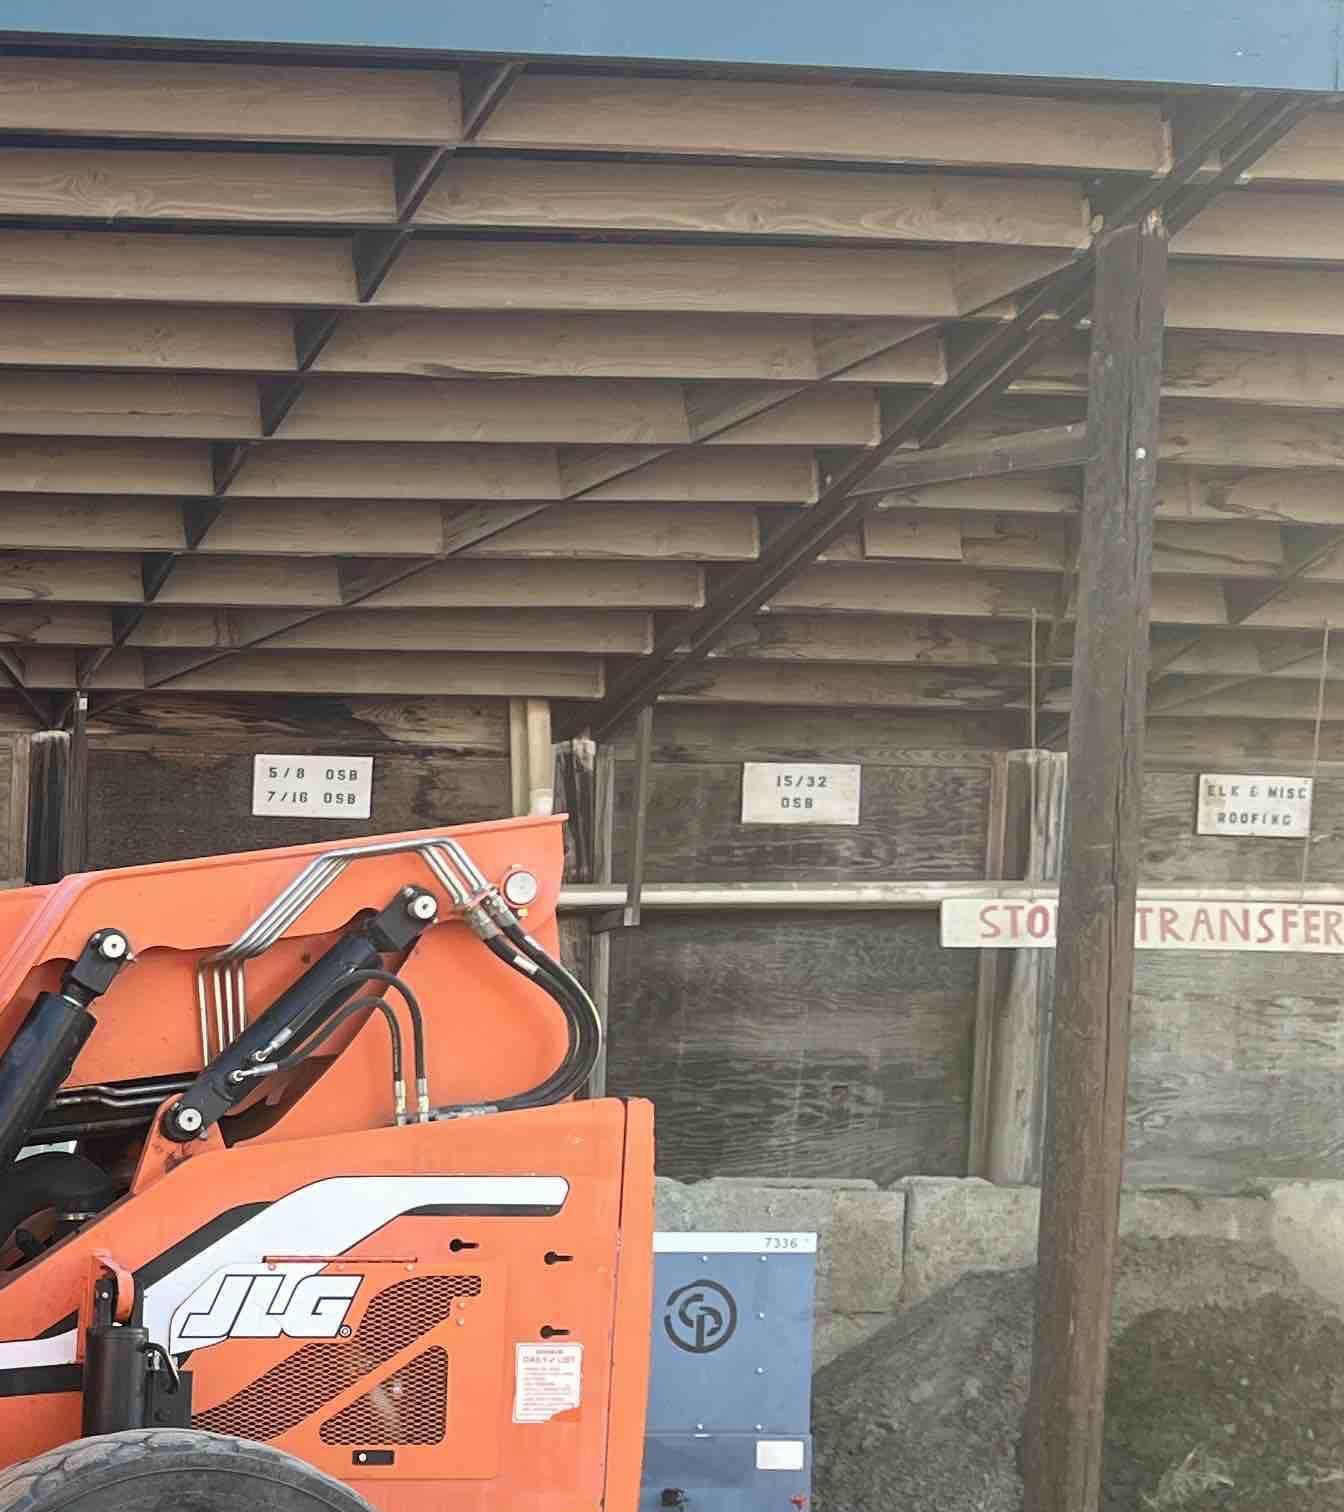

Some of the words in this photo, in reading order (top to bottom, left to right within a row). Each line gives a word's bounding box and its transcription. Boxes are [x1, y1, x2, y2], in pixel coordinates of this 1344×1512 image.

[325, 769, 358, 781] OSB
[776, 775, 827, 788] 15/32
[323, 792, 356, 805] OSB
[1207, 785, 1240, 797] ELK
[1268, 787, 1307, 800] MISC
[1217, 812, 1292, 826] ROOFING
[978, 905, 1058, 939] STO
[1136, 907, 1344, 945] TRANSFER
[764, 1237, 799, 1249] 7336
[178, 1273, 366, 1339] JLG
